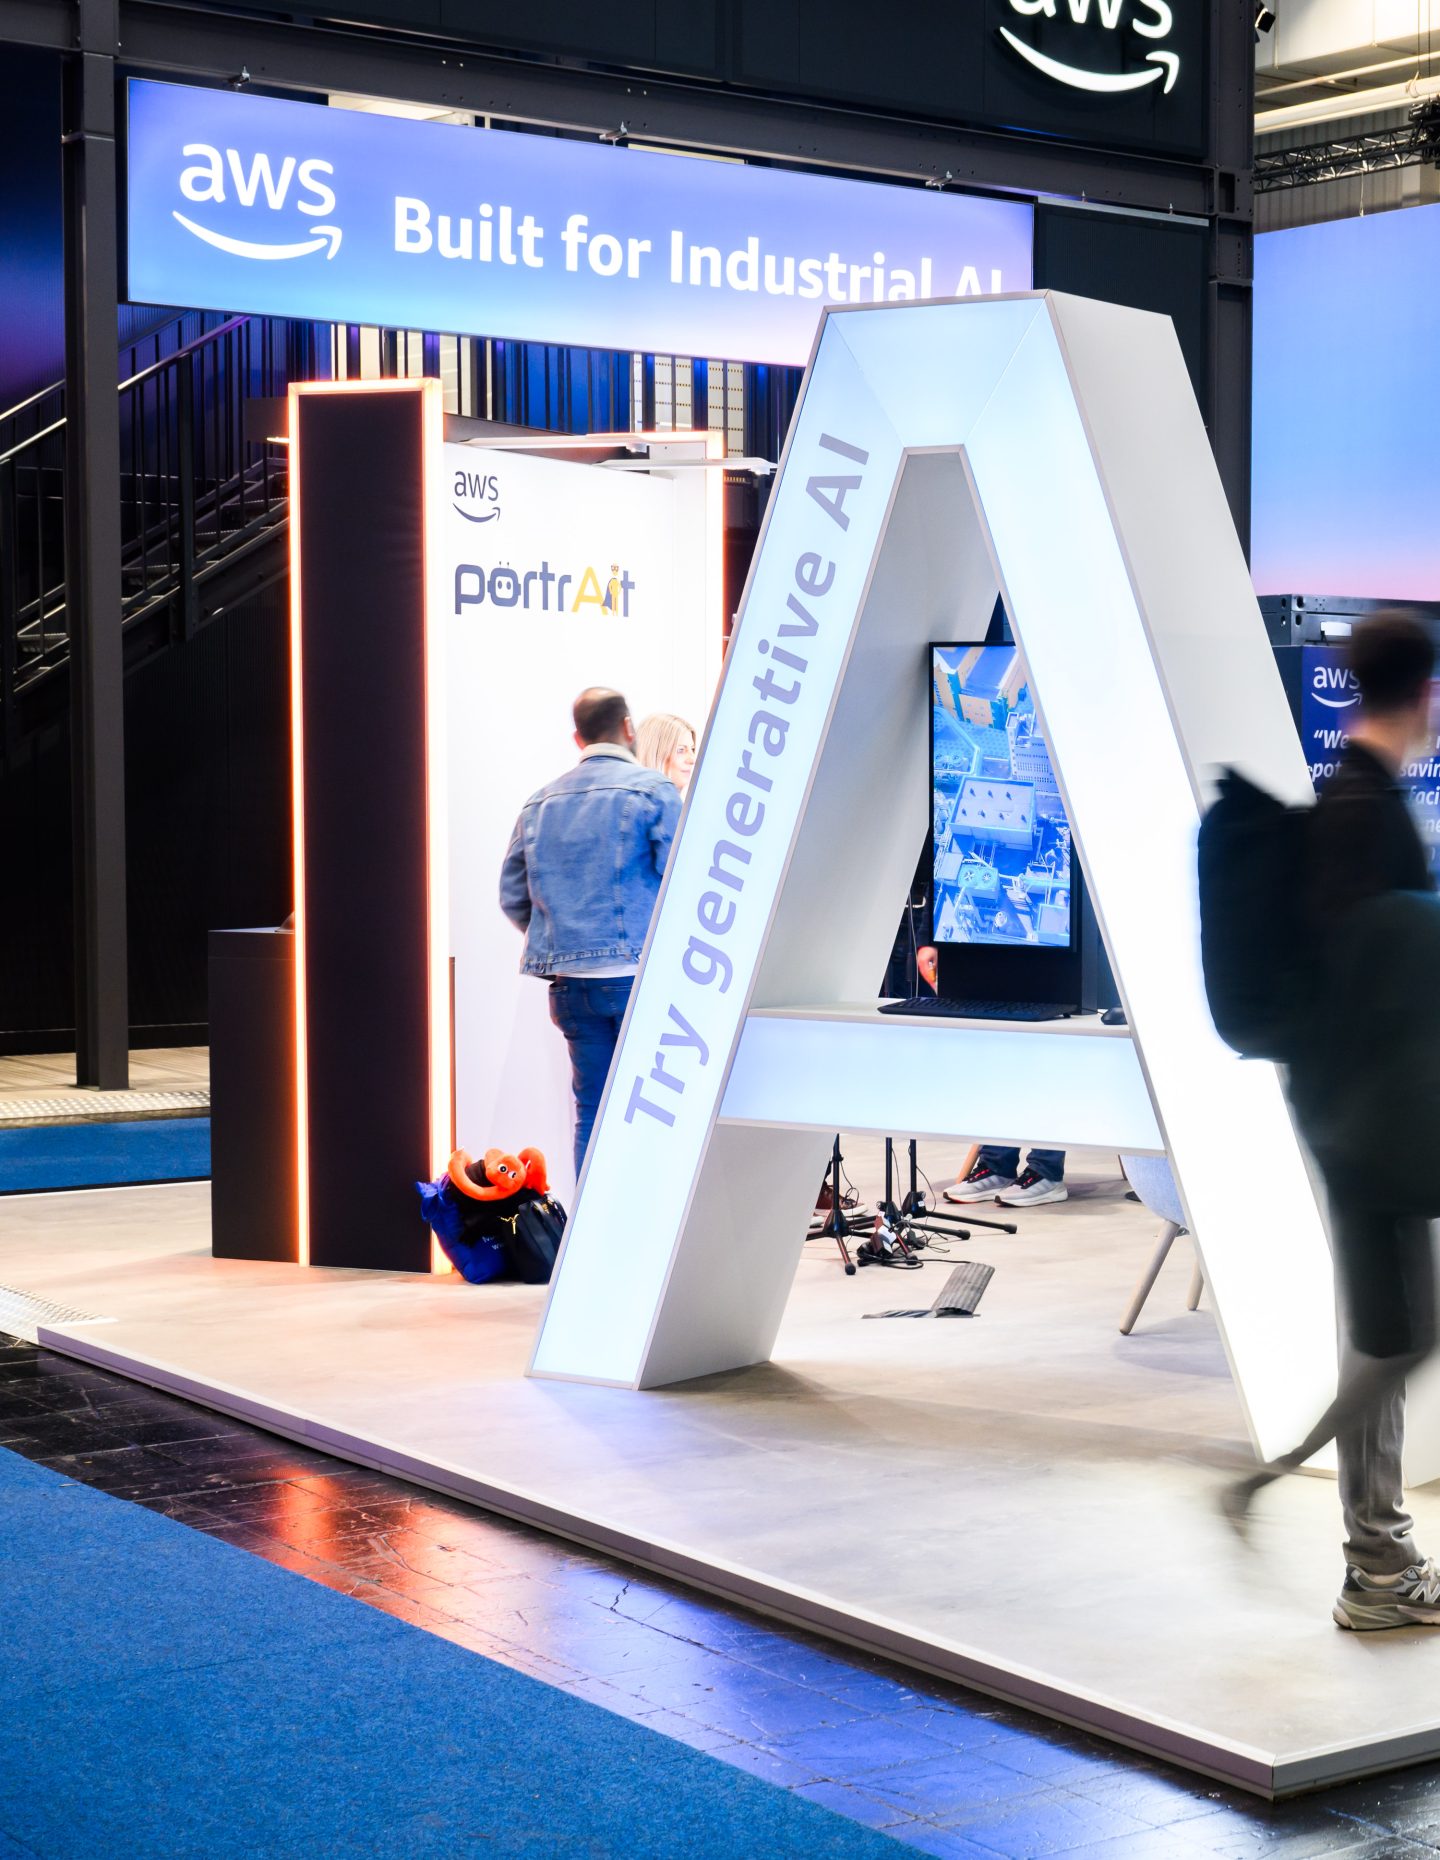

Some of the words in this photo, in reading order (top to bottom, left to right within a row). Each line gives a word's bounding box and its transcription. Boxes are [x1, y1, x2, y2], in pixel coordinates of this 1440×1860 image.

[178, 143, 337, 217] aws
[394, 195, 545, 268] Built
[561, 213, 652, 279] for
[670, 230, 932, 302] Industrial
[453, 470, 499, 502] aws
[623, 1003, 710, 1128] Try
[682, 551, 836, 995] generative
[804, 432, 870, 531] AI
